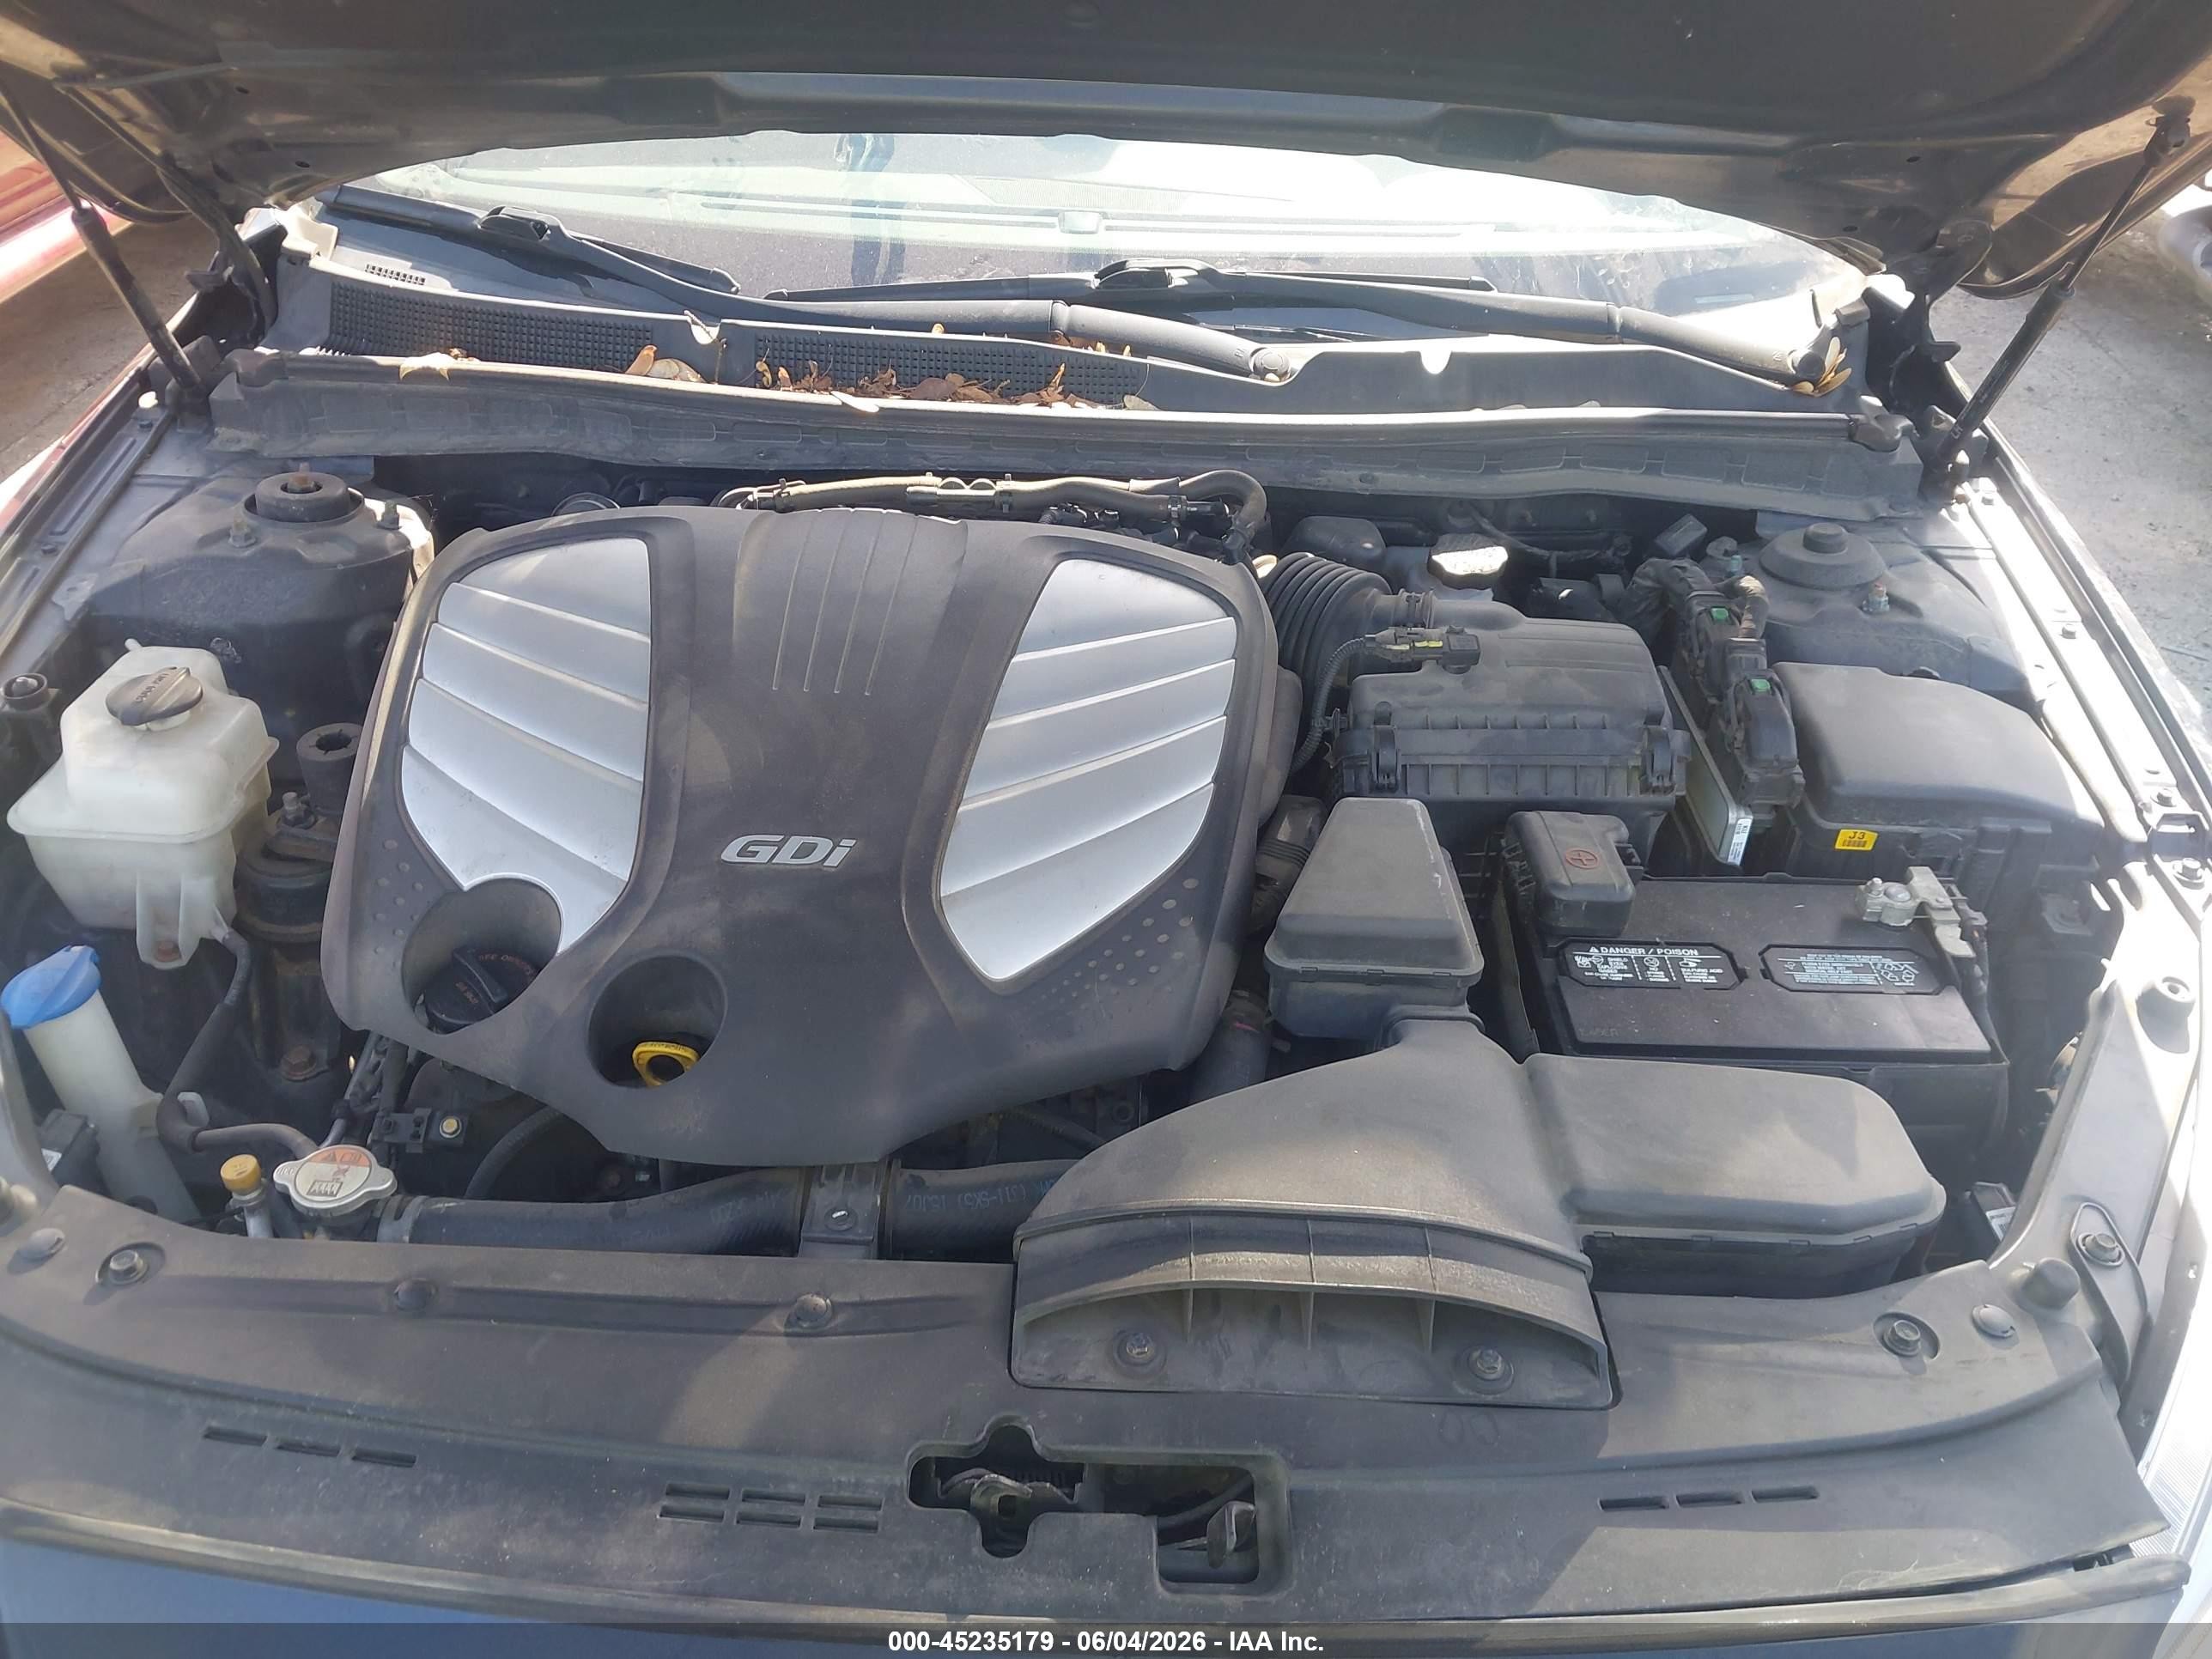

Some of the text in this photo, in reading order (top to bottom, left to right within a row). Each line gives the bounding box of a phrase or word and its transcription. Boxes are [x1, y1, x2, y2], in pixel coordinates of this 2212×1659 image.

[1848, 830, 1866, 840] J3
[720, 834, 857, 867] GDi
[1600, 946, 1646, 955] DANGER
[1656, 947, 1698, 956] POISON
